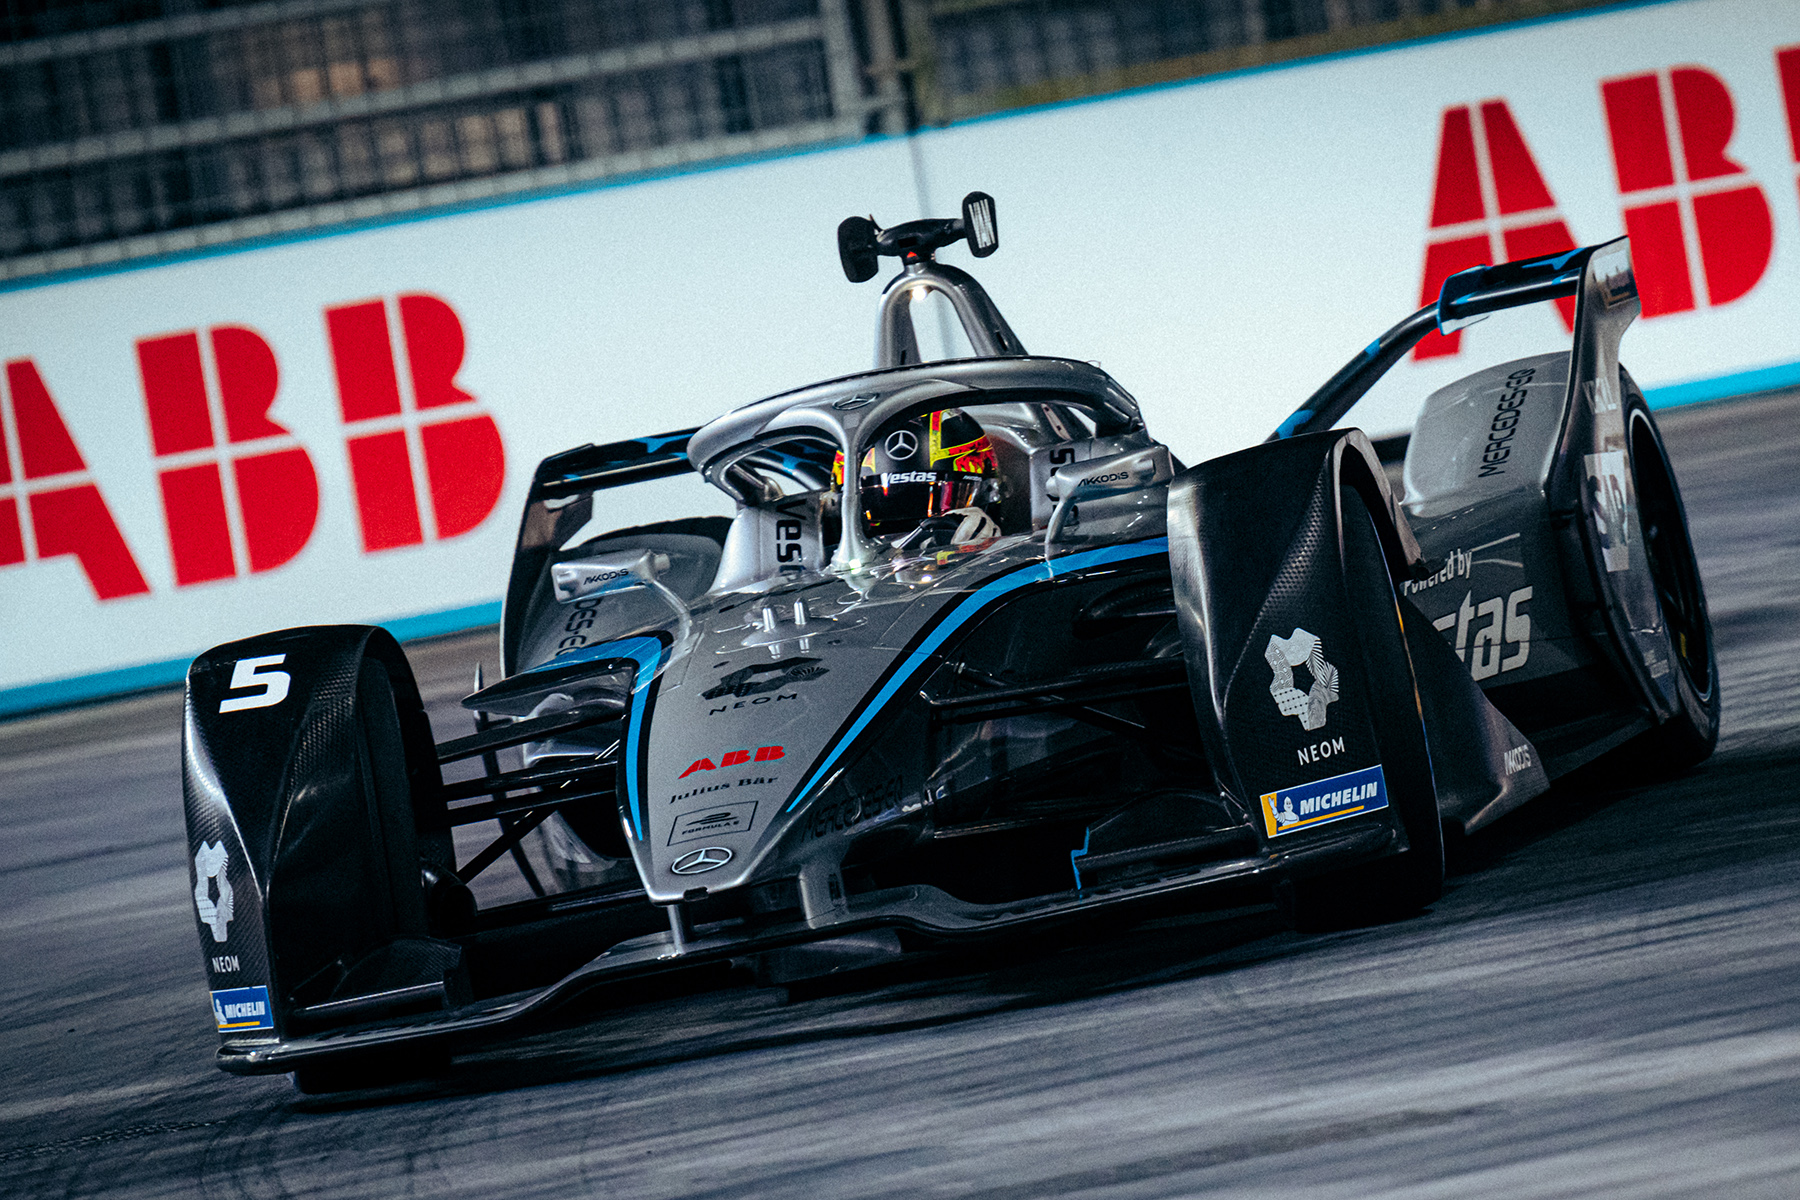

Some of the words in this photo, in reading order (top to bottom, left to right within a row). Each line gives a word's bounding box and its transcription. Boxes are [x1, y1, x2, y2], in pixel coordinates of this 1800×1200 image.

[1409, 43, 1800, 364] AB
[1478, 368, 1536, 478] MERCEDES-EQ
[0, 290, 507, 603] ABB
[880, 471, 937, 485] Vestas
[1457, 548, 1472, 579] by
[218, 653, 292, 714] 5
[709, 693, 798, 716] NEOM
[678, 745, 786, 780] ABB
[1297, 736, 1345, 766] NEOM
[669, 782, 730, 805] Julius
[1300, 781, 1378, 815] MICHELIN
[682, 822, 730, 835] FORMULA
[211, 954, 240, 973] NEOM
[224, 1000, 266, 1019] MICHELIN
